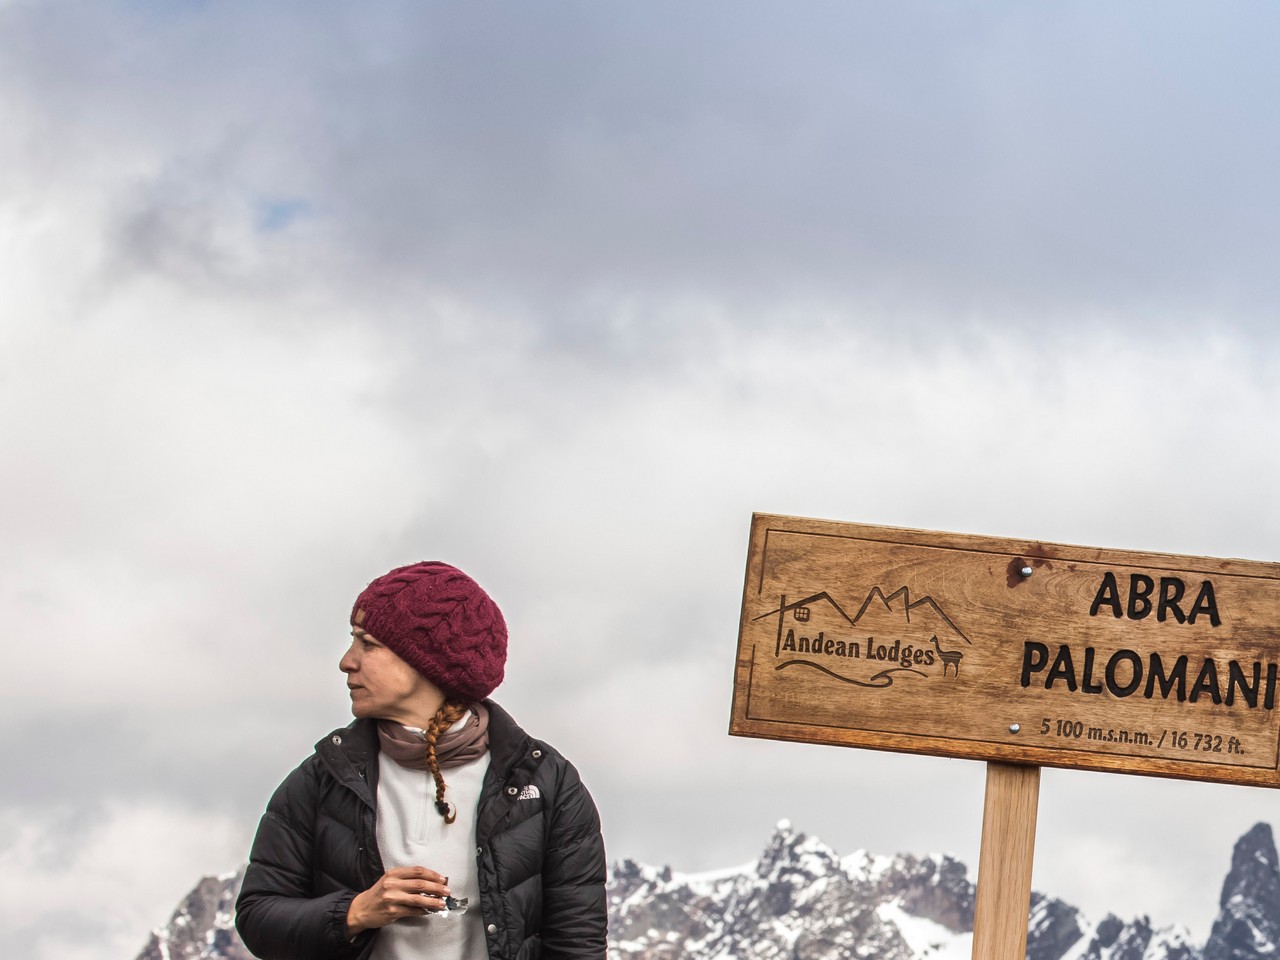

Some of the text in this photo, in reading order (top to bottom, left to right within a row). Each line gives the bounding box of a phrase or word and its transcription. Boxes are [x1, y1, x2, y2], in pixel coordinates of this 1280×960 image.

[1089, 571, 1222, 627] ABRA
[782, 628, 935, 668] Andean Lodges
[1020, 641, 1278, 710] PALOMANI
[1040, 718, 1245, 755] 5 100 m.s.n.m. / 16 732 ft.
